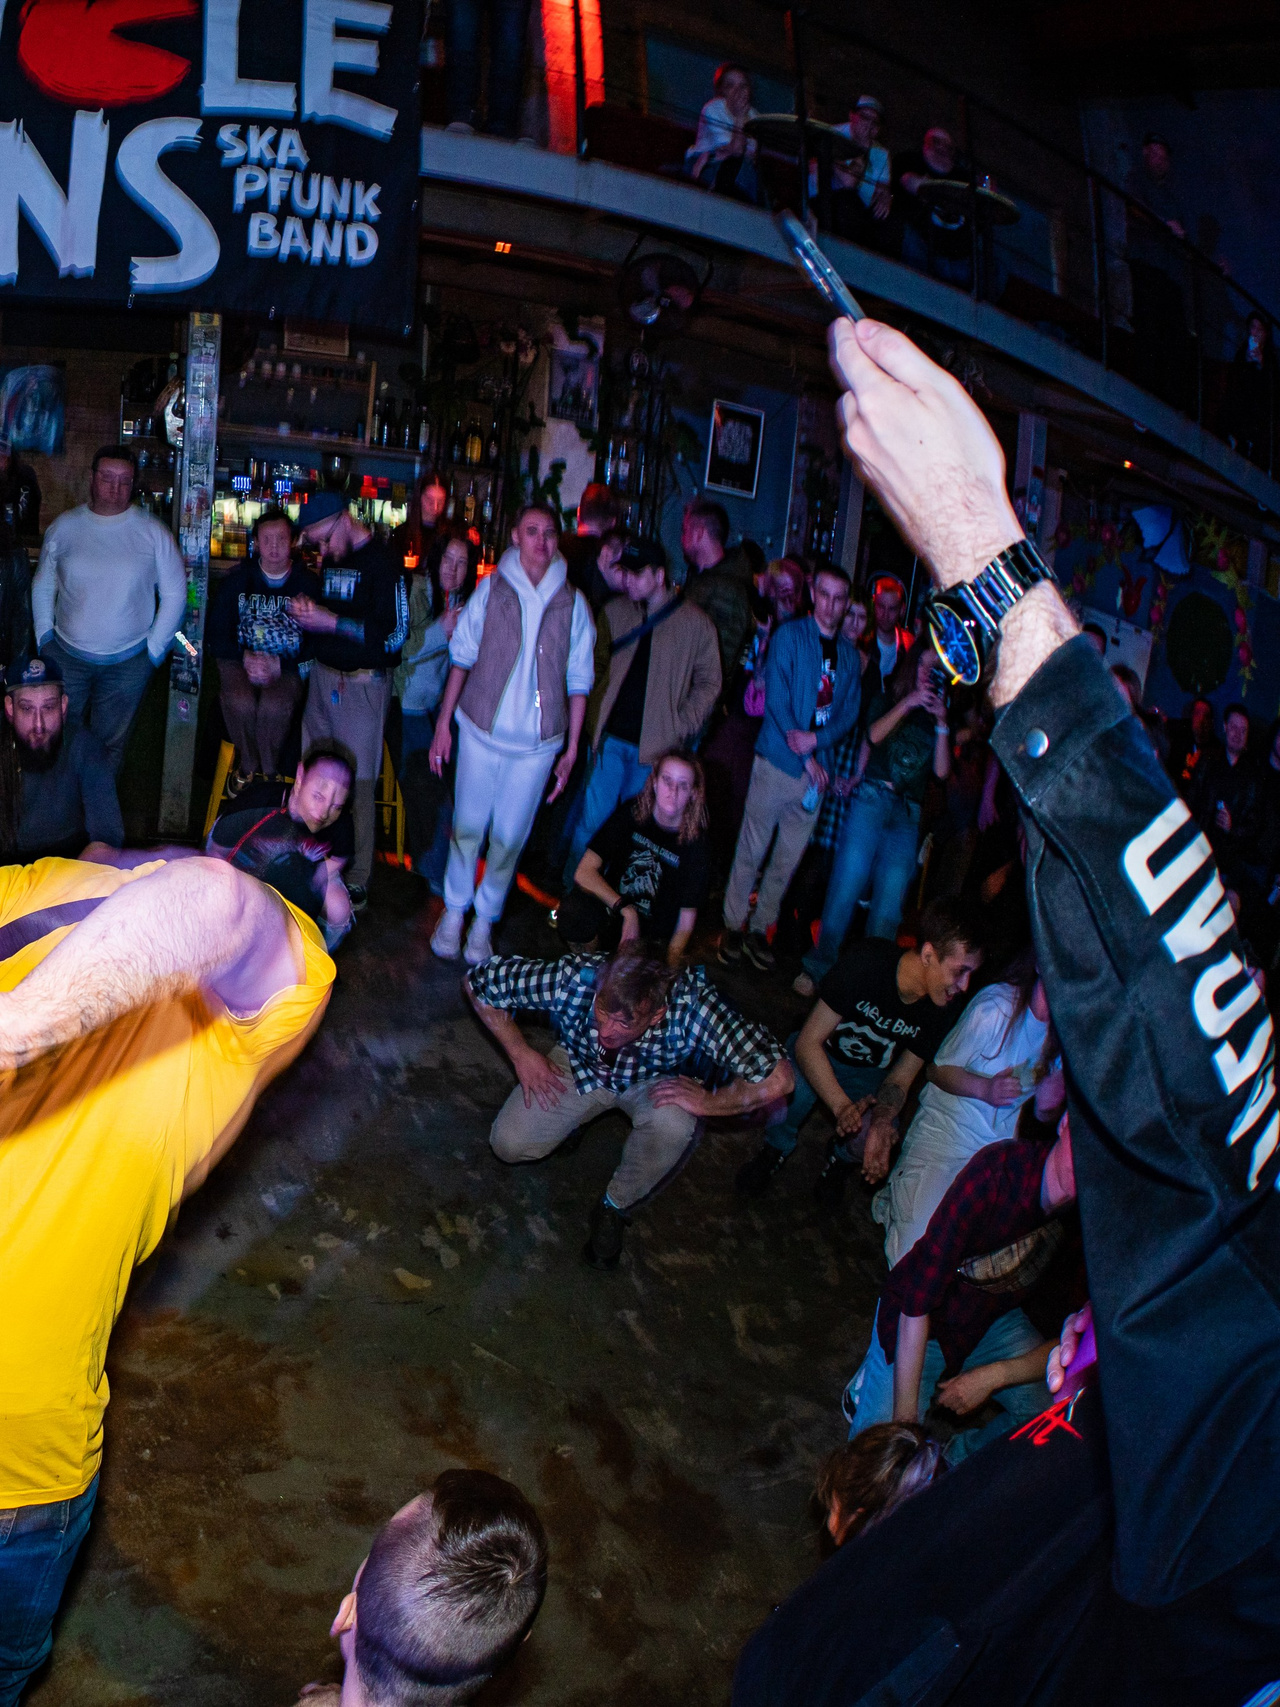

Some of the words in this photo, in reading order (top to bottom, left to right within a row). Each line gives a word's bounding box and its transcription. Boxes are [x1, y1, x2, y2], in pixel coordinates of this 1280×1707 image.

[215, 124, 311, 171] SKA
[232, 165, 382, 224] PFUNK
[246, 211, 380, 268] BAND
